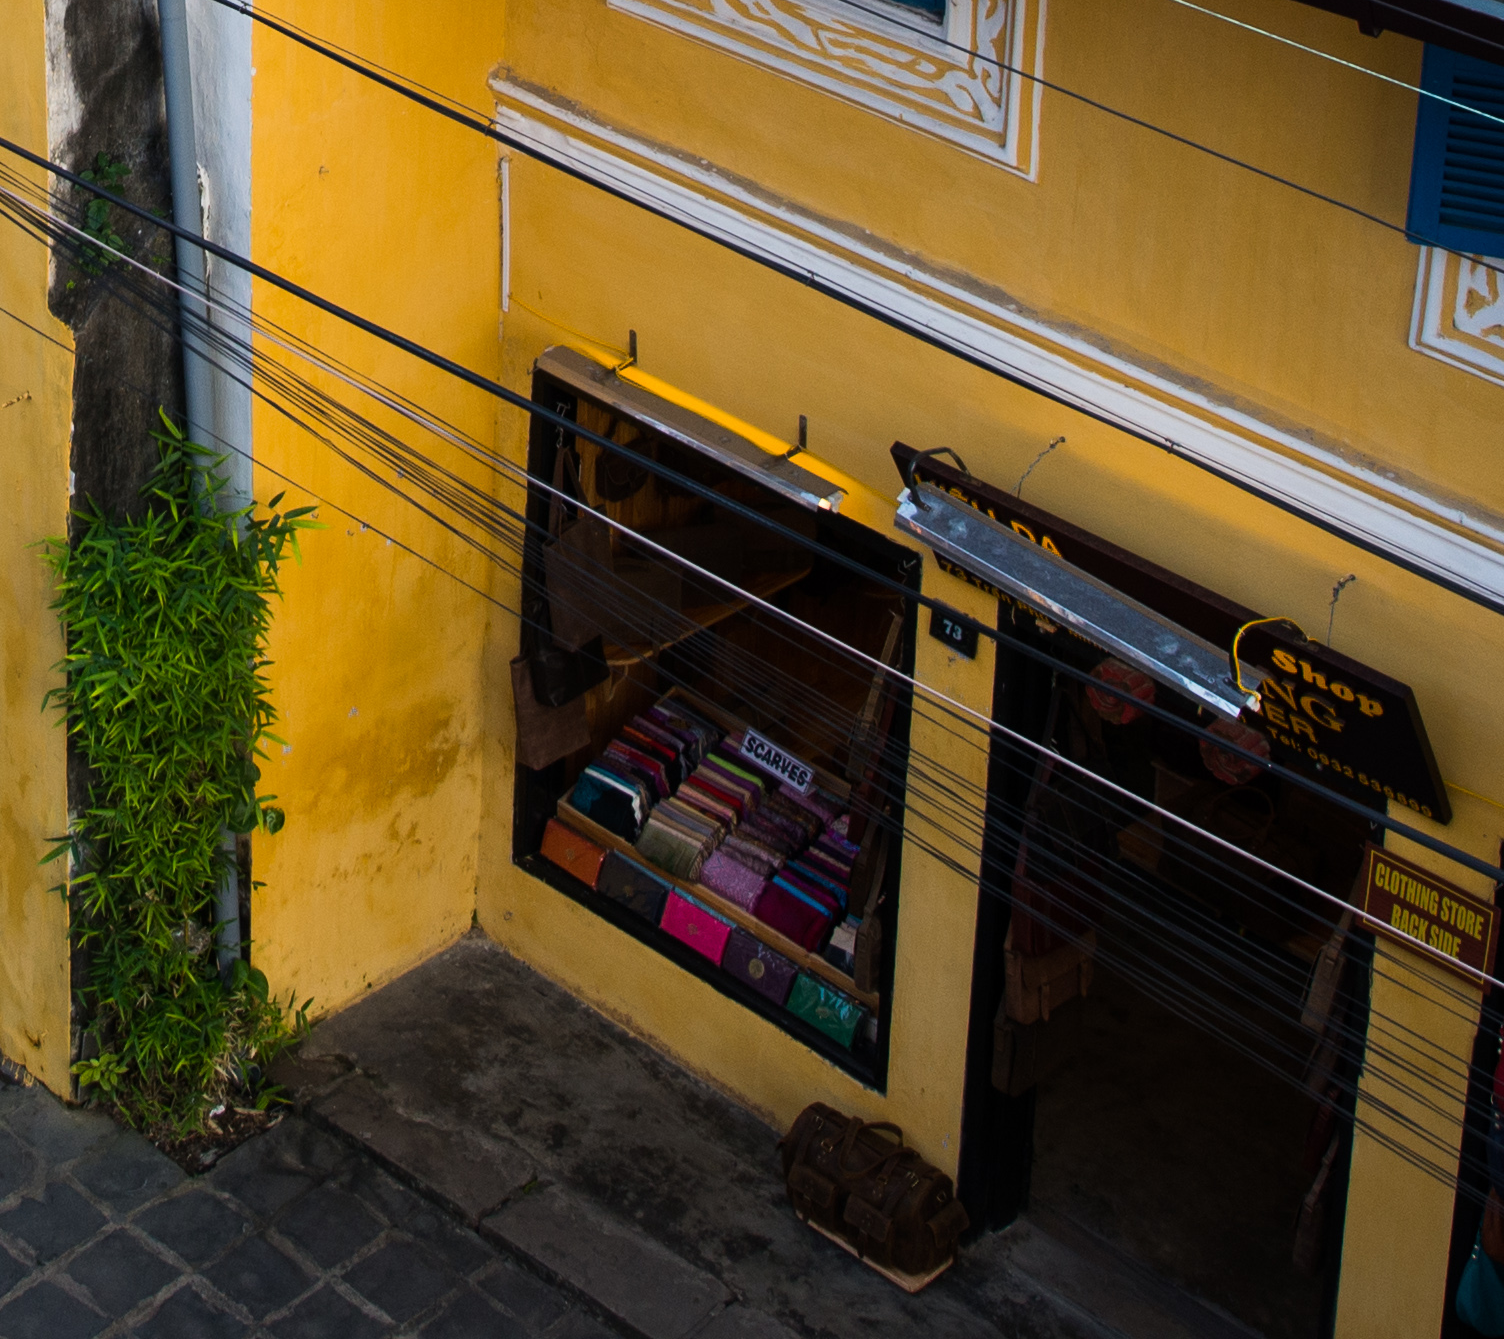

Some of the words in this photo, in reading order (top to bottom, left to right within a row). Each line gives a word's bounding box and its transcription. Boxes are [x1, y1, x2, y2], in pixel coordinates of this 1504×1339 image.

[943, 619, 963, 641] 73
[1271, 649, 1384, 717] Shop
[1259, 700, 1318, 744] ER
[745, 736, 808, 787] SCARVES
[1375, 862, 1439, 917] CLOTHING
[1441, 897, 1484, 941] STORE
[1391, 903, 1429, 943] BACK
[1429, 924, 1462, 959] SIDE
